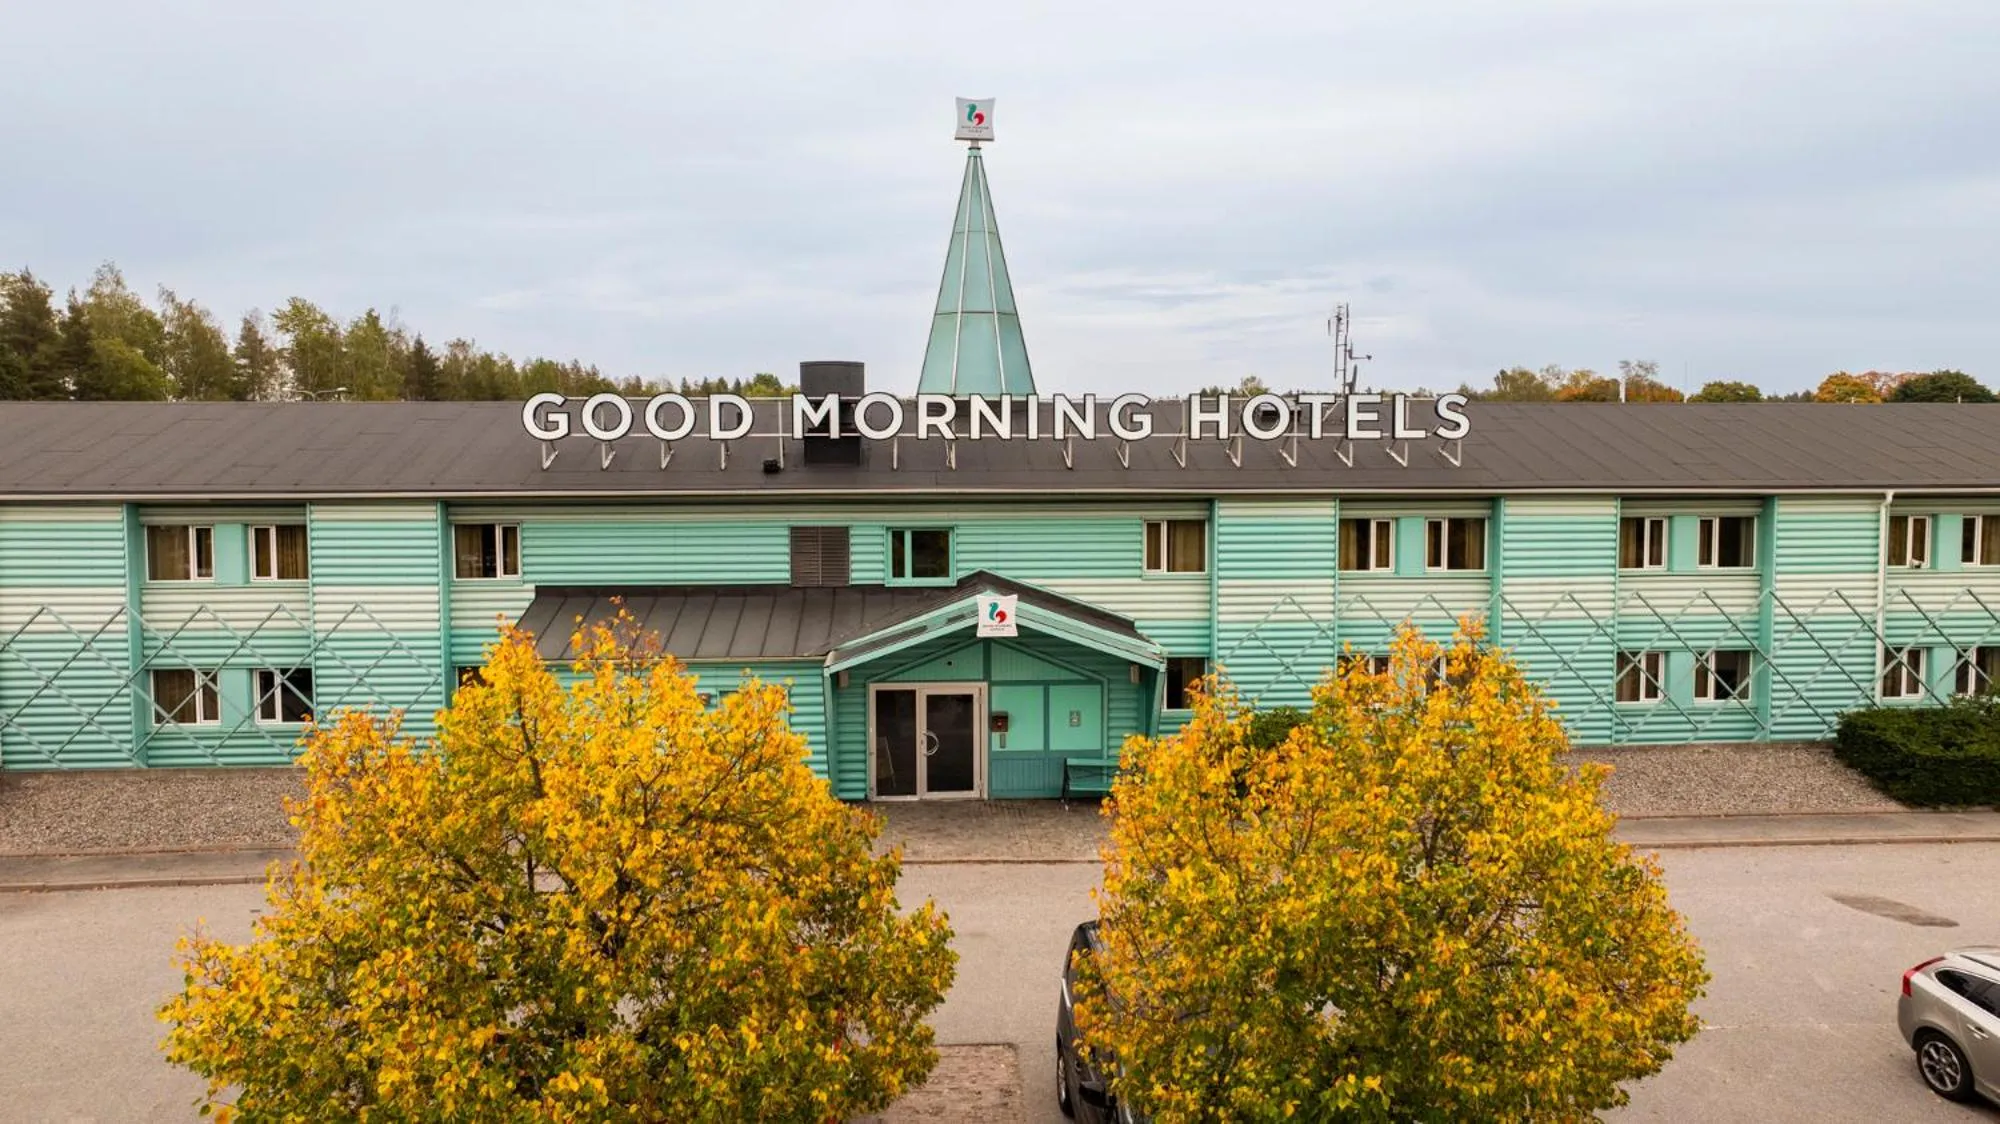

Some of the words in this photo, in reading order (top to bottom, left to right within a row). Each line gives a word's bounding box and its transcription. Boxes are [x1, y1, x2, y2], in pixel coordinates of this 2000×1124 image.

[522, 392, 755, 441] GOOD
[792, 392, 1153, 441] MORNING
[1188, 392, 1472, 441] HOTELS
